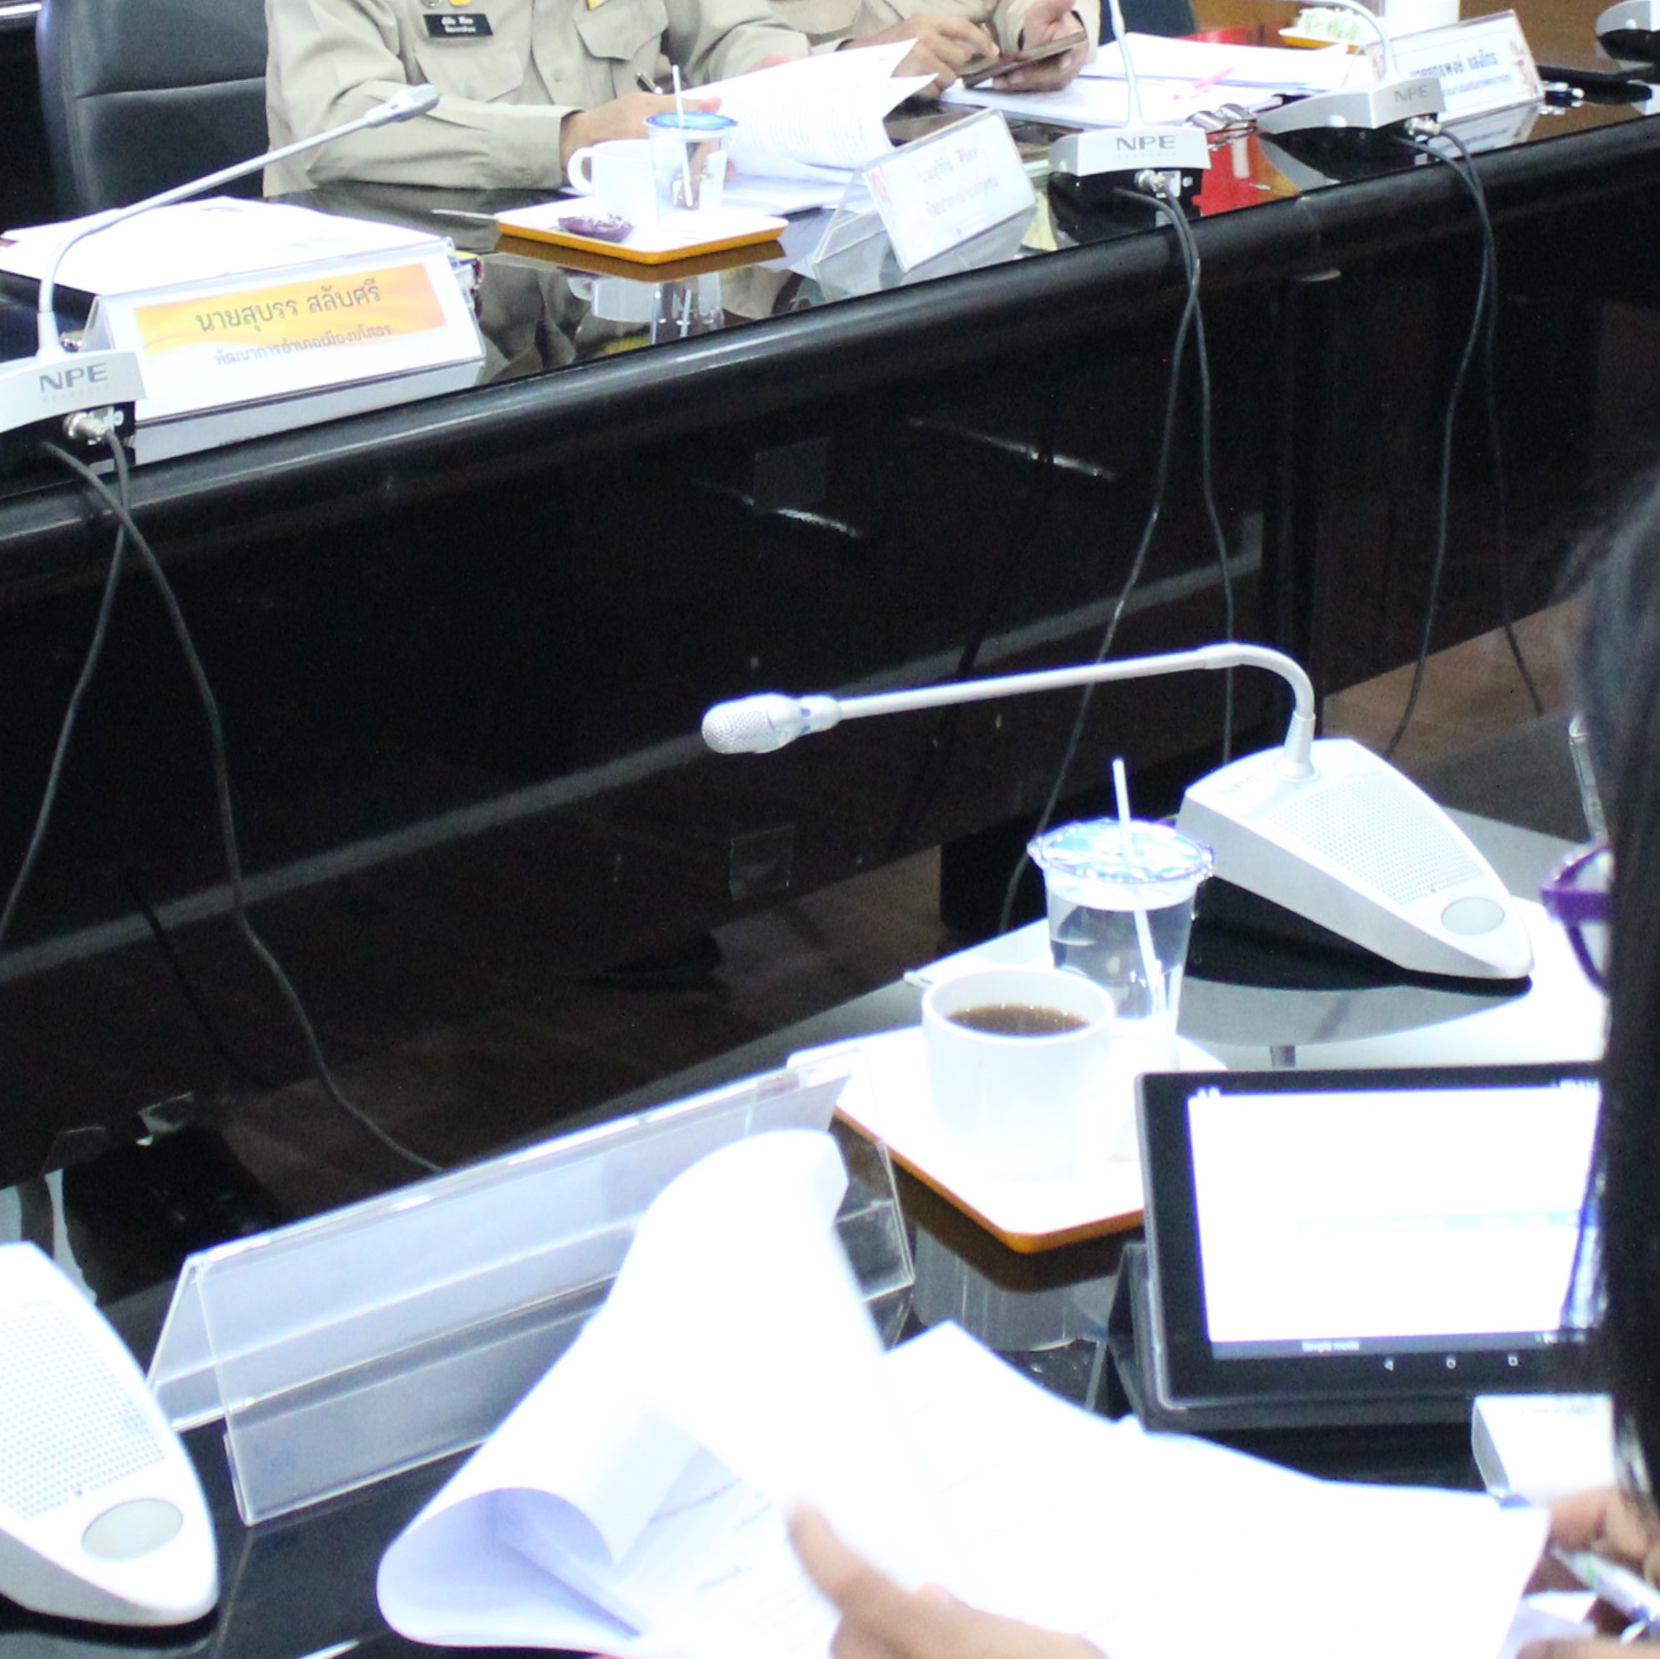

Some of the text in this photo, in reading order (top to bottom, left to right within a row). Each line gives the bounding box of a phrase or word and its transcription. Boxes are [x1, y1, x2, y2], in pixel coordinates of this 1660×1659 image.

[1394, 85, 1429, 103] NPE
[1116, 134, 1177, 151] NPE
[307, 277, 382, 314] สลับศรี
[39, 362, 108, 393] NPE
